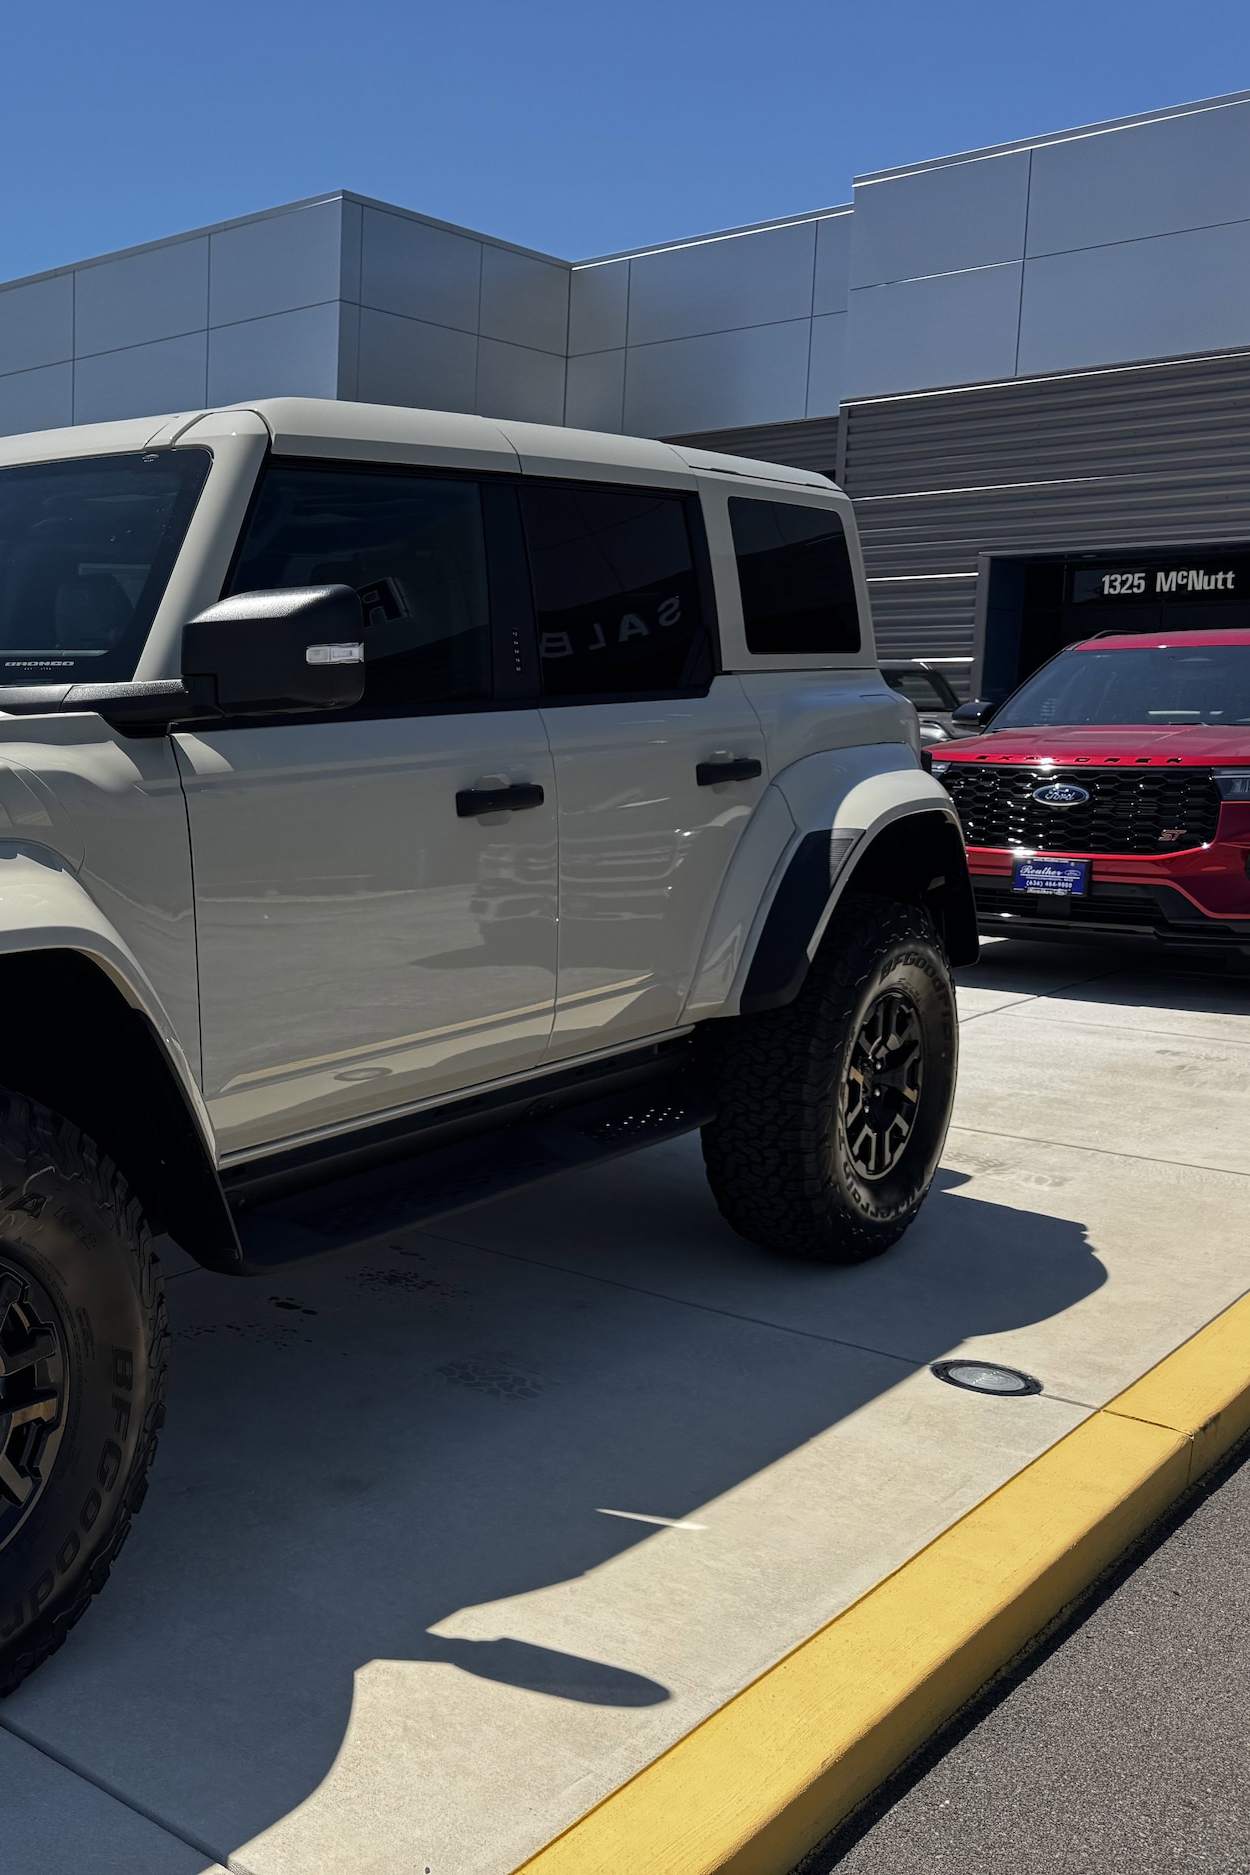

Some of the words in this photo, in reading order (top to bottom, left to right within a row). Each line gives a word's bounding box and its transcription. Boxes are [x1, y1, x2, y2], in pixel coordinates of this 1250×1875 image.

[1102, 573, 1146, 595] 1325
[1156, 570, 1236, 593] McNutt
[1158, 830, 1188, 841] ST
